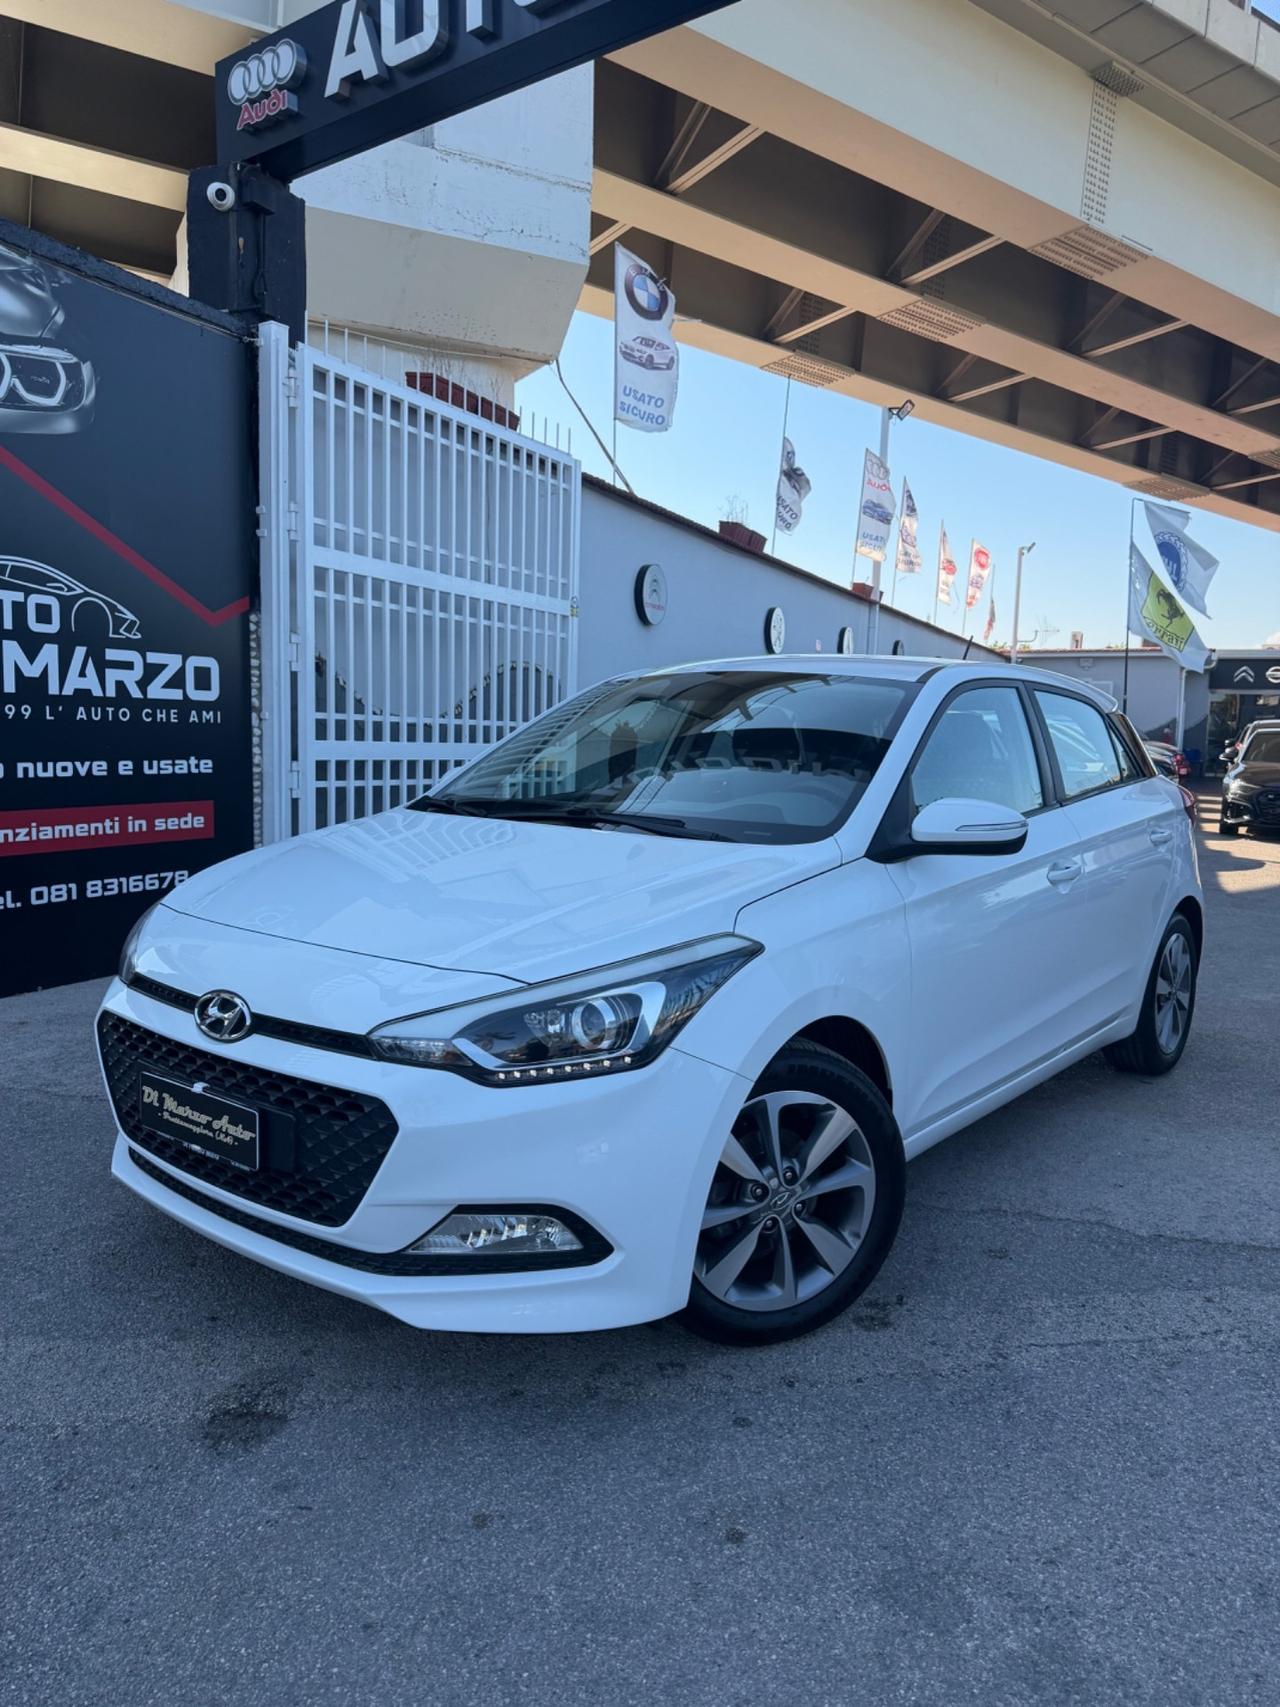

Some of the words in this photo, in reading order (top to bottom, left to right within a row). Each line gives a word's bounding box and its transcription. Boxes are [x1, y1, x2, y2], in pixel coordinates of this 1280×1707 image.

[324, 0, 538, 98] AU
[237, 88, 288, 130] Audi
[623, 385, 665, 409] USATO
[619, 401, 666, 427] SICURO
[2, 639, 220, 702] MARZO
[4, 704, 32, 720] 99
[76, 706, 130, 722] AUTO
[142, 708, 179, 723] CHE
[189, 711, 221, 724] AMI
[16, 760, 108, 779] nuove
[118, 760, 134, 776] e
[142, 756, 213, 775] usate
[127, 816, 147, 833] in
[154, 812, 205, 831] sede
[30, 883, 78, 906] 081
[86, 869, 189, 898] 8316678
[212, 1115, 257, 1141] Auto
